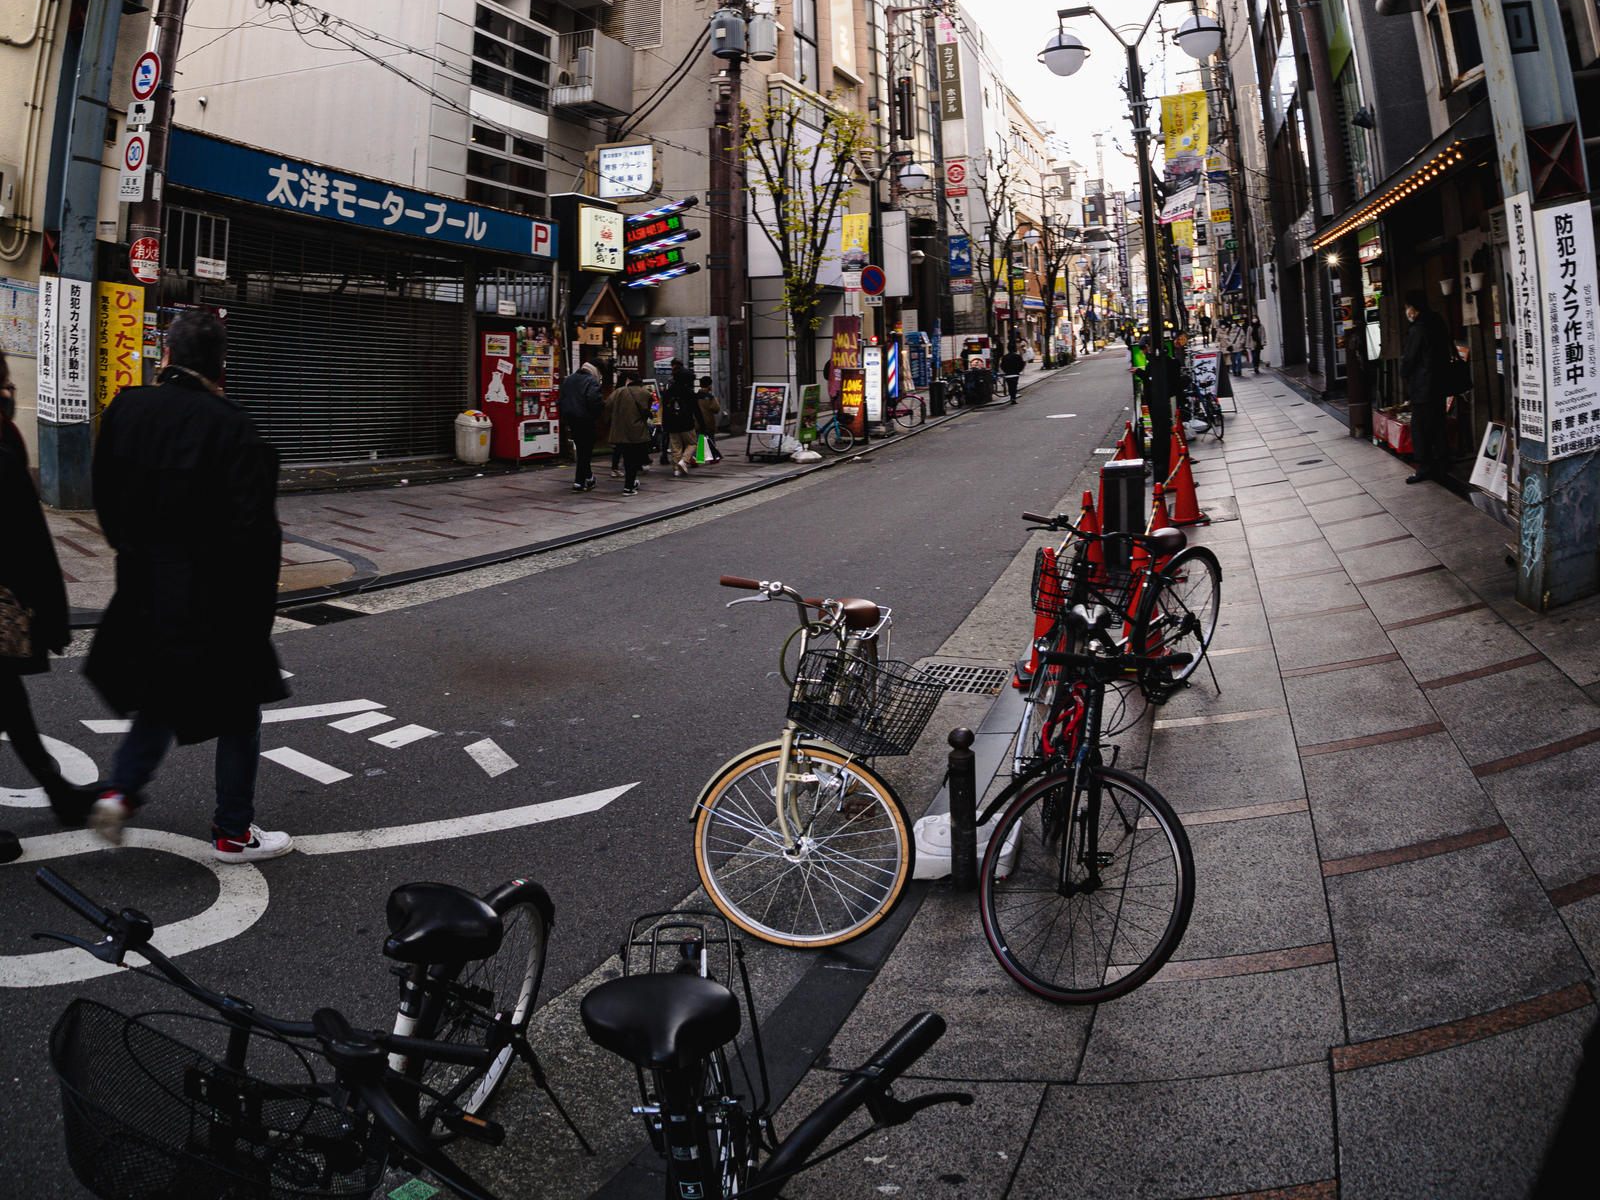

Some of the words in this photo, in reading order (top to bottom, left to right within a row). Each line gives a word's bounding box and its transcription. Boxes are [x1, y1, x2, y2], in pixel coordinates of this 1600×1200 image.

[945, 88, 958, 113] ホテル
[129, 145, 141, 161] 30
[266, 163, 487, 242] 太洋モータープール
[533, 223, 548, 252] P
[1554, 213, 1585, 385] 防犯カメラ作動中
[69, 284, 82, 383] 防犯カメラ作動中
[842, 379, 862, 392] LONG
[842, 393, 862, 406] DINH
[1552, 408, 1600, 434] 南警察署
[687, 1185, 695, 1194] S
